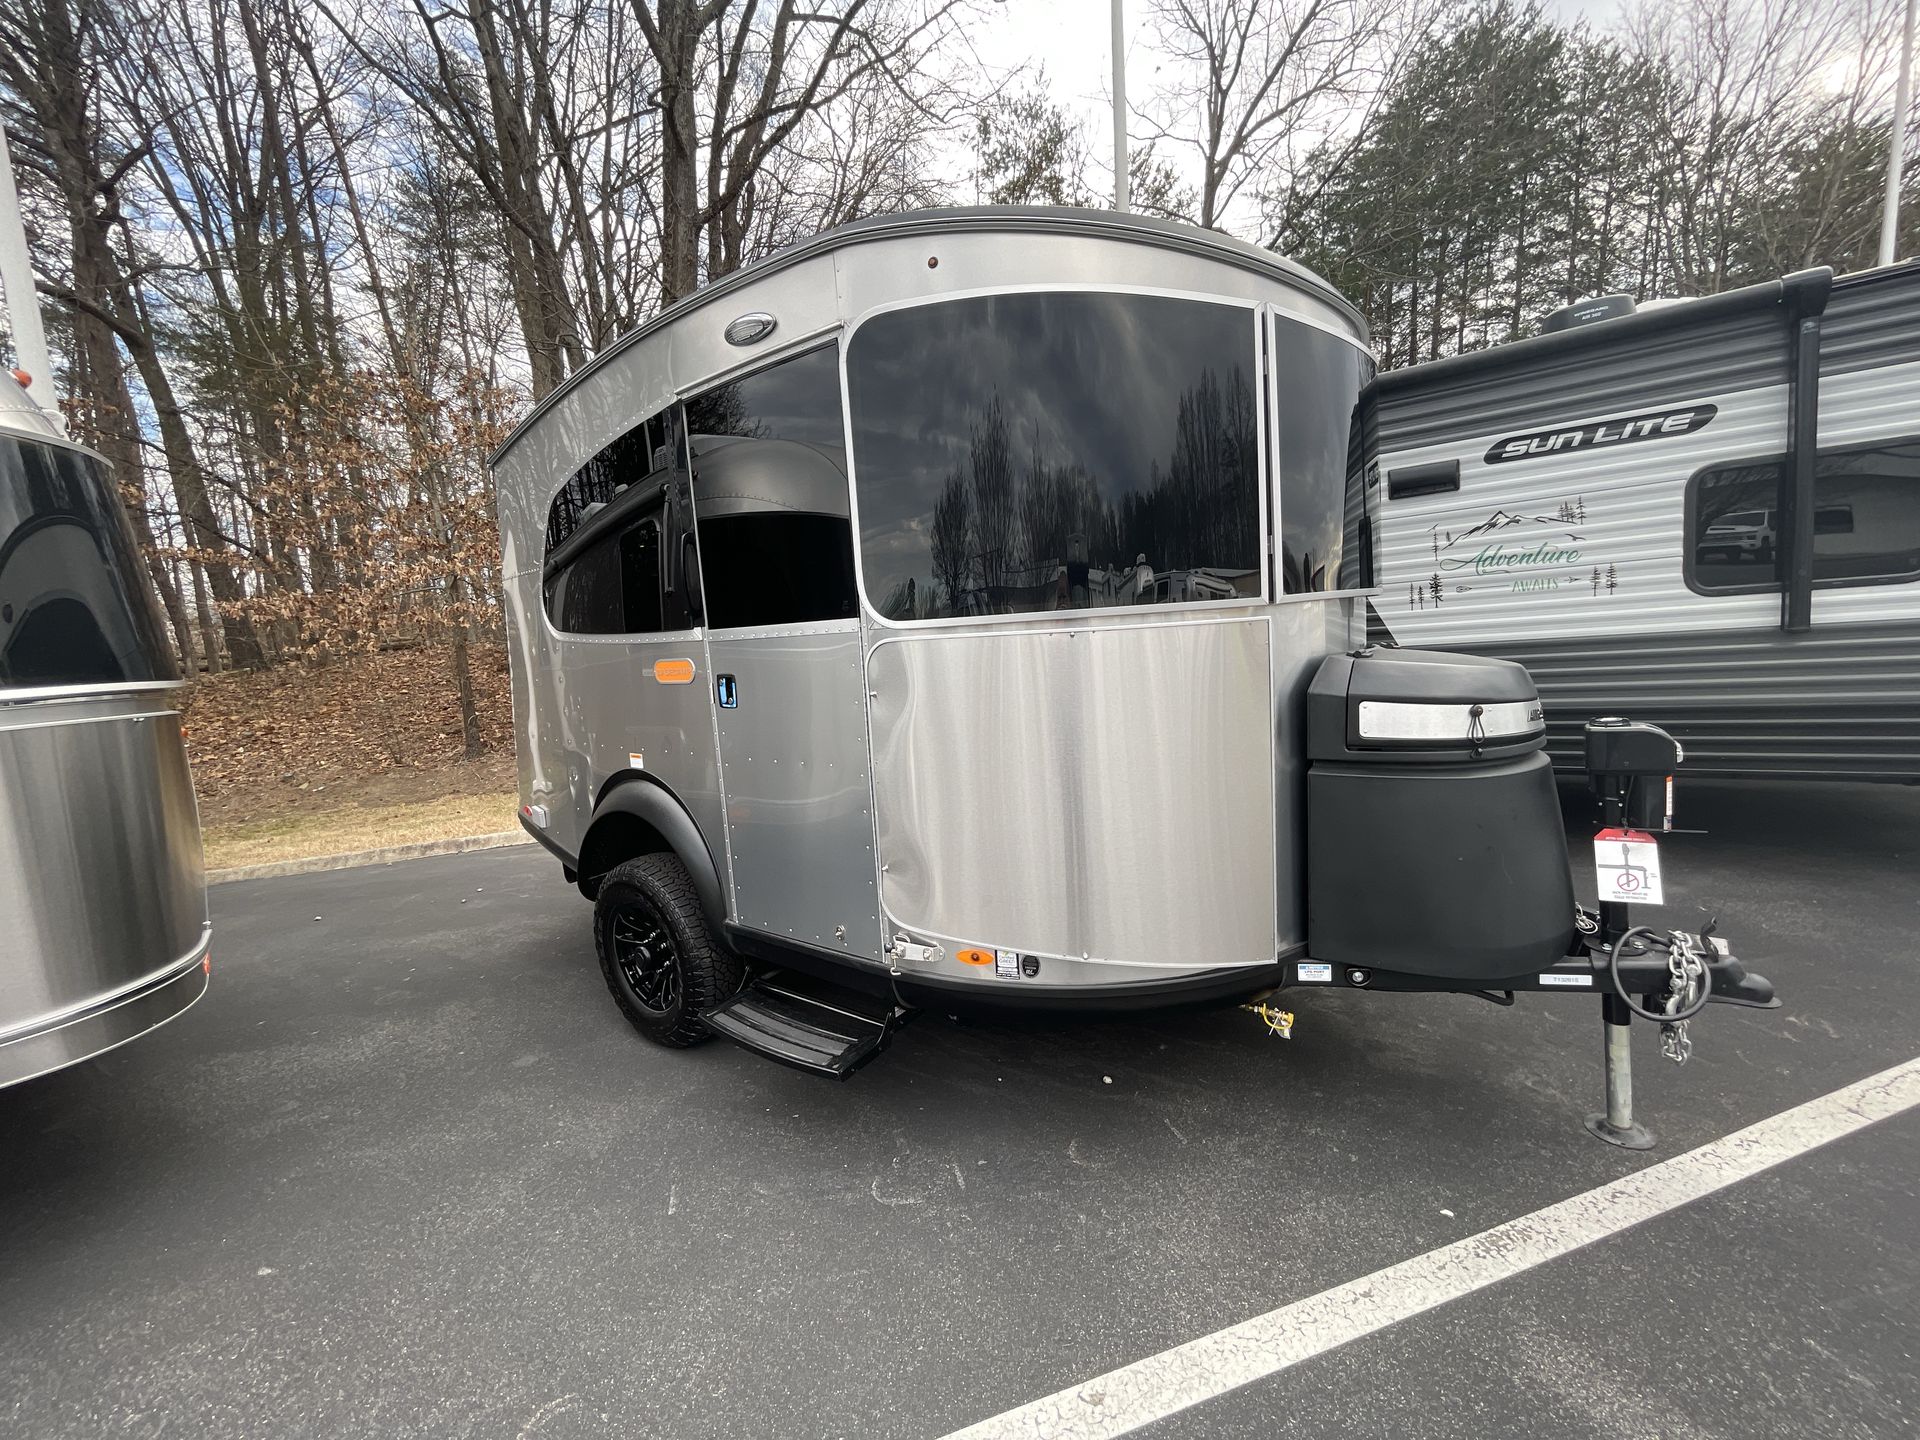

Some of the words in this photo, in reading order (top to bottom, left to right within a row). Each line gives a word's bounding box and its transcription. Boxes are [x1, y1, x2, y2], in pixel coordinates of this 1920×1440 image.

[1501, 431, 1584, 458] SUN
[1592, 412, 1695, 444] LITE
[1440, 542, 1583, 576] Adventure
[1512, 577, 1559, 593] AWAITS
